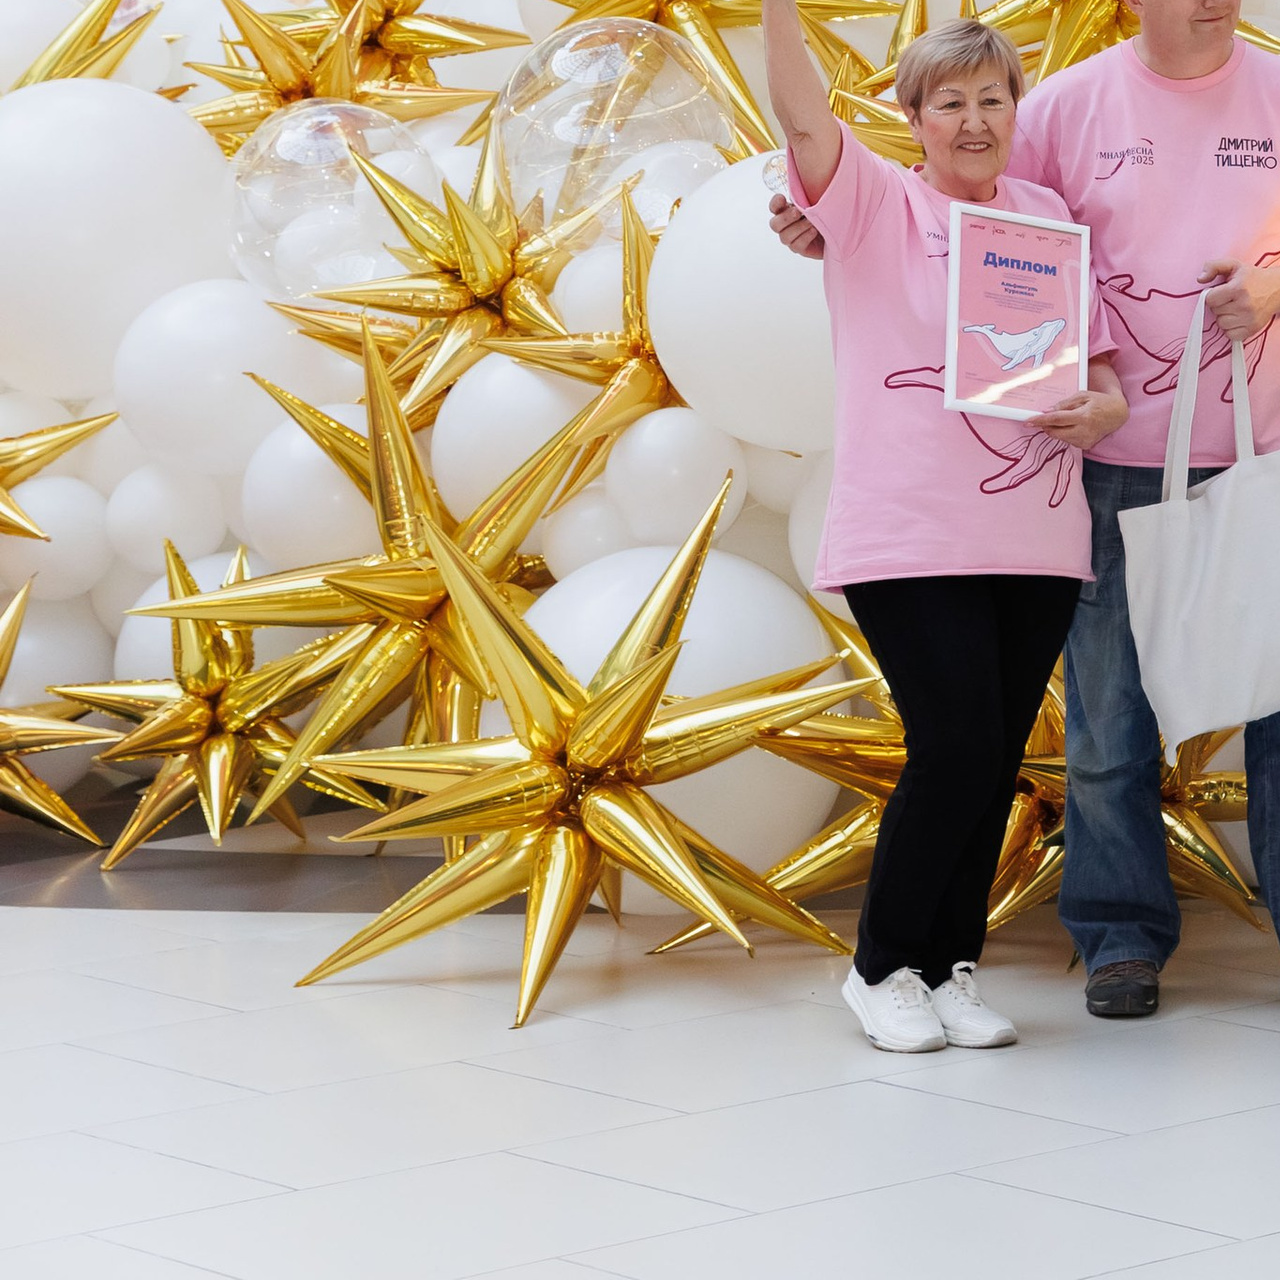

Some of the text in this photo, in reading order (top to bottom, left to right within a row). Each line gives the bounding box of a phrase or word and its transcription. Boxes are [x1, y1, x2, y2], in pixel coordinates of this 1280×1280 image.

[1218, 137, 1273, 153] ДМИТРИЙ
[1131, 155, 1155, 167] 2025
[1214, 153, 1278, 170] ТИЩЕНКО
[983, 251, 1057, 277] Диплом
